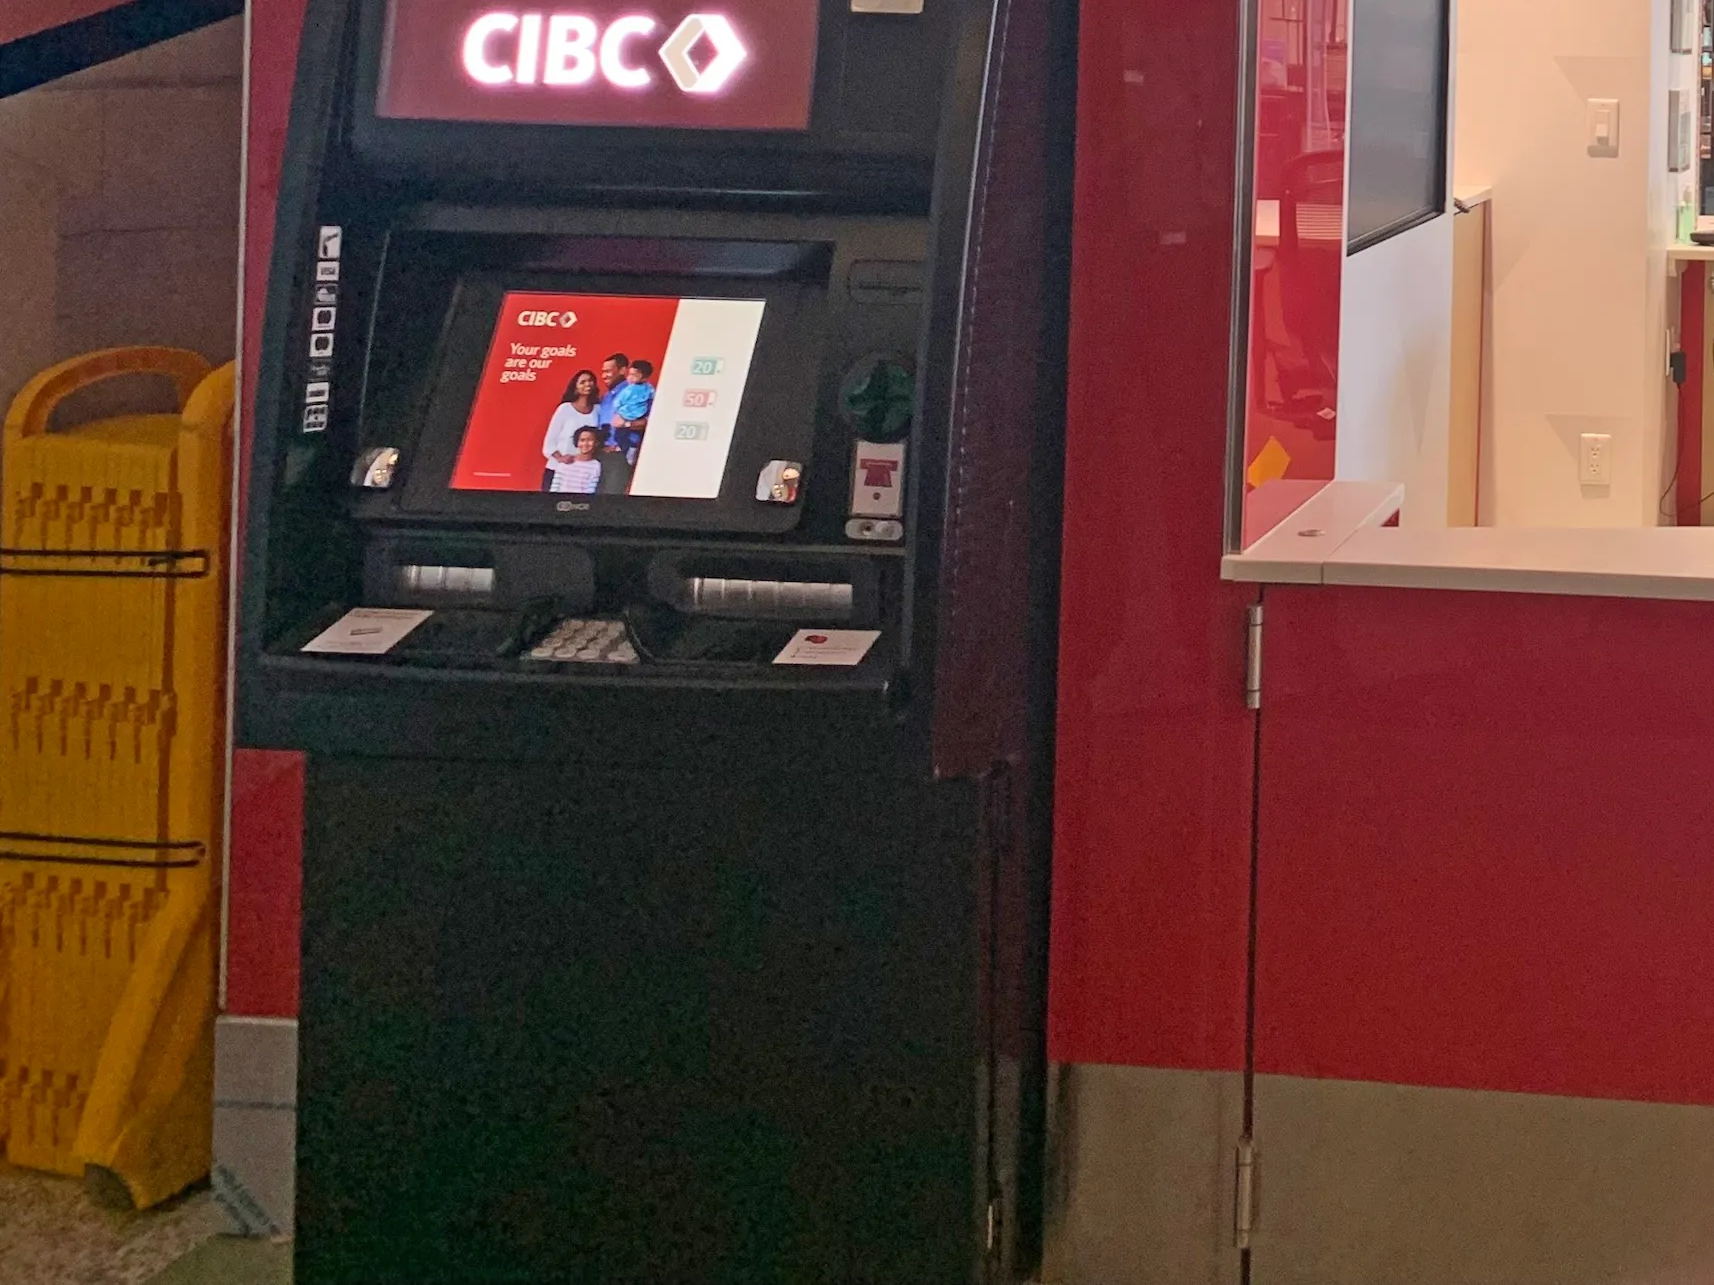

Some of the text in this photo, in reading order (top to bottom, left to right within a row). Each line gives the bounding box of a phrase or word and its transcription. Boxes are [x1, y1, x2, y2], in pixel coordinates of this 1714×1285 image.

[462, 13, 655, 90] CIBC
[517, 310, 559, 327] CIBC
[510, 342, 577, 359] Your goals
[504, 359, 553, 370] are our
[693, 361, 713, 374] 20
[500, 368, 537, 384] goals
[685, 393, 704, 406] 50
[676, 425, 696, 439] 20
